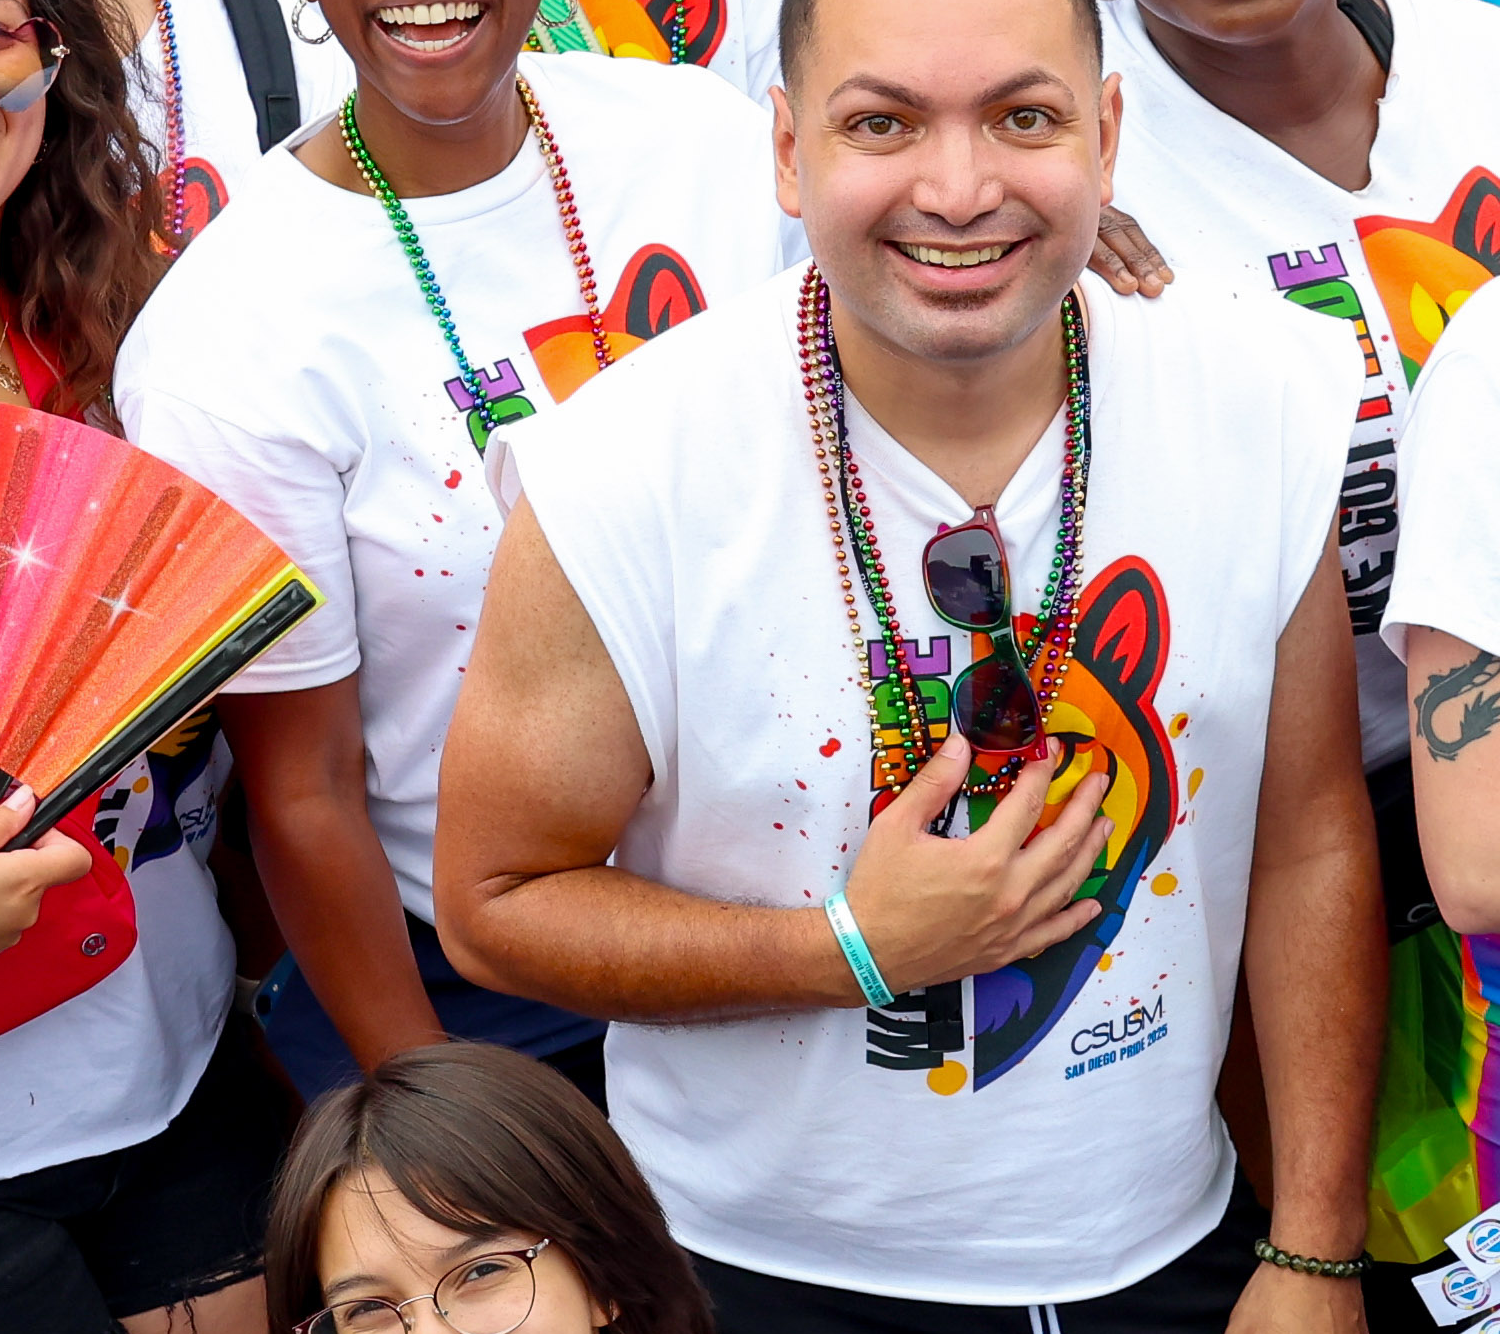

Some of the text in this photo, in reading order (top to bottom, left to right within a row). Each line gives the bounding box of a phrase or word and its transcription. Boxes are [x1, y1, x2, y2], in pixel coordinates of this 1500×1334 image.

[1065, 1023, 1168, 1080] SAN DIEGO PRIDE 2025
[1071, 995, 1163, 1055] CSUSM
